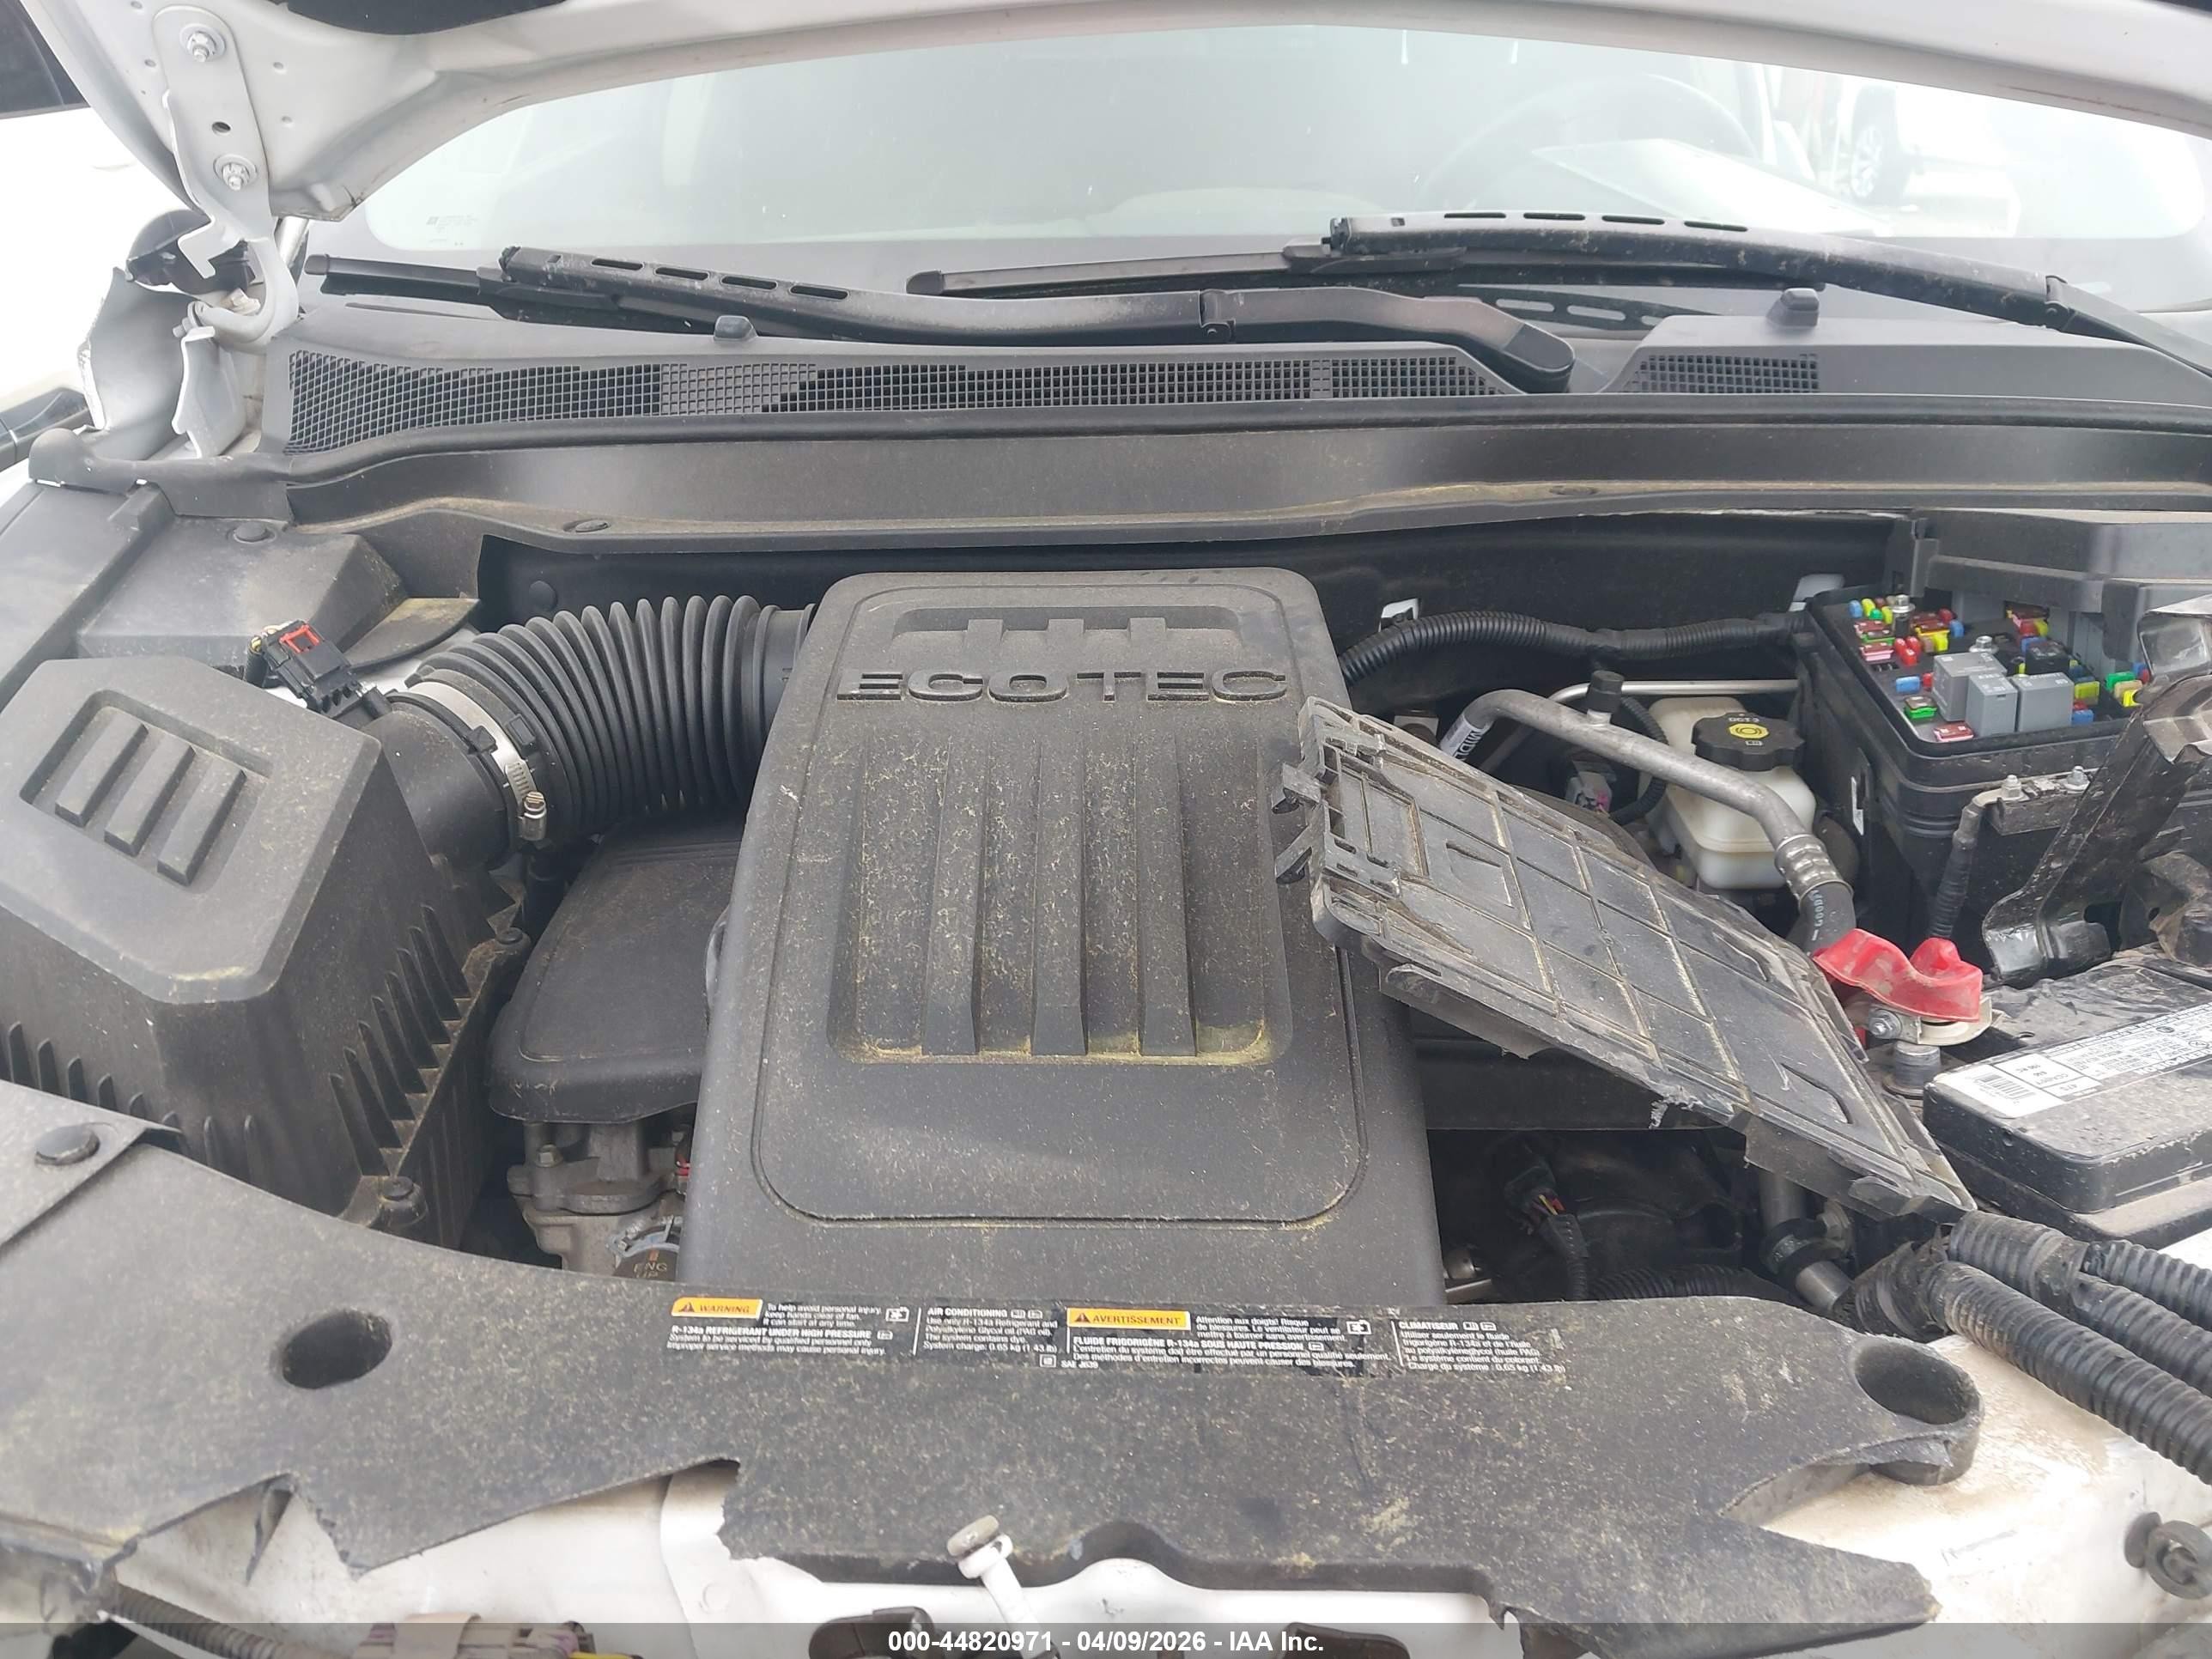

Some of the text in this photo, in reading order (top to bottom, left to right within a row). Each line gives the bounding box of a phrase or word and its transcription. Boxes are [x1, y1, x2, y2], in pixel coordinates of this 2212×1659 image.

[837, 671, 1286, 702] ECOTEC
[1455, 730, 1483, 762] MIDL
[700, 1304, 750, 1313] WARNING
[778, 1304, 796, 1313] help
[821, 1305, 857, 1314] personal
[927, 1307, 1008, 1318] AIR CONDITIONING
[927, 1316, 942, 1325] Use
[963, 1318, 994, 1327] R-134a
[995, 1318, 1041, 1328] Refrigerant
[1042, 1320, 1058, 1328] and
[1092, 1315, 1182, 1325] AVERTISSEMENT
[1196, 1316, 1233, 1325] Attention
[1280, 1318, 1310, 1328] Risque
[977, 1326, 1004, 1334] Glycol
[1398, 1321, 1459, 1330] CLIMATISEUR
[672, 1325, 872, 1339] R-134a REFRIGERANT UNDER HIGH PRESSURE
[1197, 1331, 1225, 1340] mettre
[1233, 1332, 1263, 1340] tourner
[1309, 1327, 1329, 1335] peut
[1400, 1330, 1430, 1339] Utiliser
[670, 1334, 701, 1342] System
[774, 1337, 810, 1346] qualified
[925, 1333, 940, 1341] The
[942, 1334, 972, 1342] system
[973, 1334, 1009, 1343] contains
[667, 1340, 704, 1350] Improper
[706, 1342, 737, 1351] service
[738, 1343, 775, 1352] methods
[776, 1345, 795, 1353] may
[860, 1347, 886, 1356] injury.
[923, 1340, 955, 1350] System
[1073, 1336, 1304, 1351] FLUIDE FRIGORIGÈNE R-134a SOUS HAUTE PRESSION
[1449, 1340, 1481, 1348] R-134a
[1073, 1345, 1117, 1353] L'entretien
[1167, 1347, 1184, 1356] doit
[1239, 1350, 1255, 1358] par
[1268, 1350, 1311, 1358] personnel
[1344, 1352, 1392, 1361] seulement.
[1494, 1348, 1519, 1357] (huile
[1073, 1352, 1091, 1361] Des
[1133, 1354, 1180, 1364] d'entretien
[1229, 1357, 1264, 1366] peuvent
[1312, 1359, 1357, 1368] blessures.
[1408, 1363, 1439, 1371] Charge
